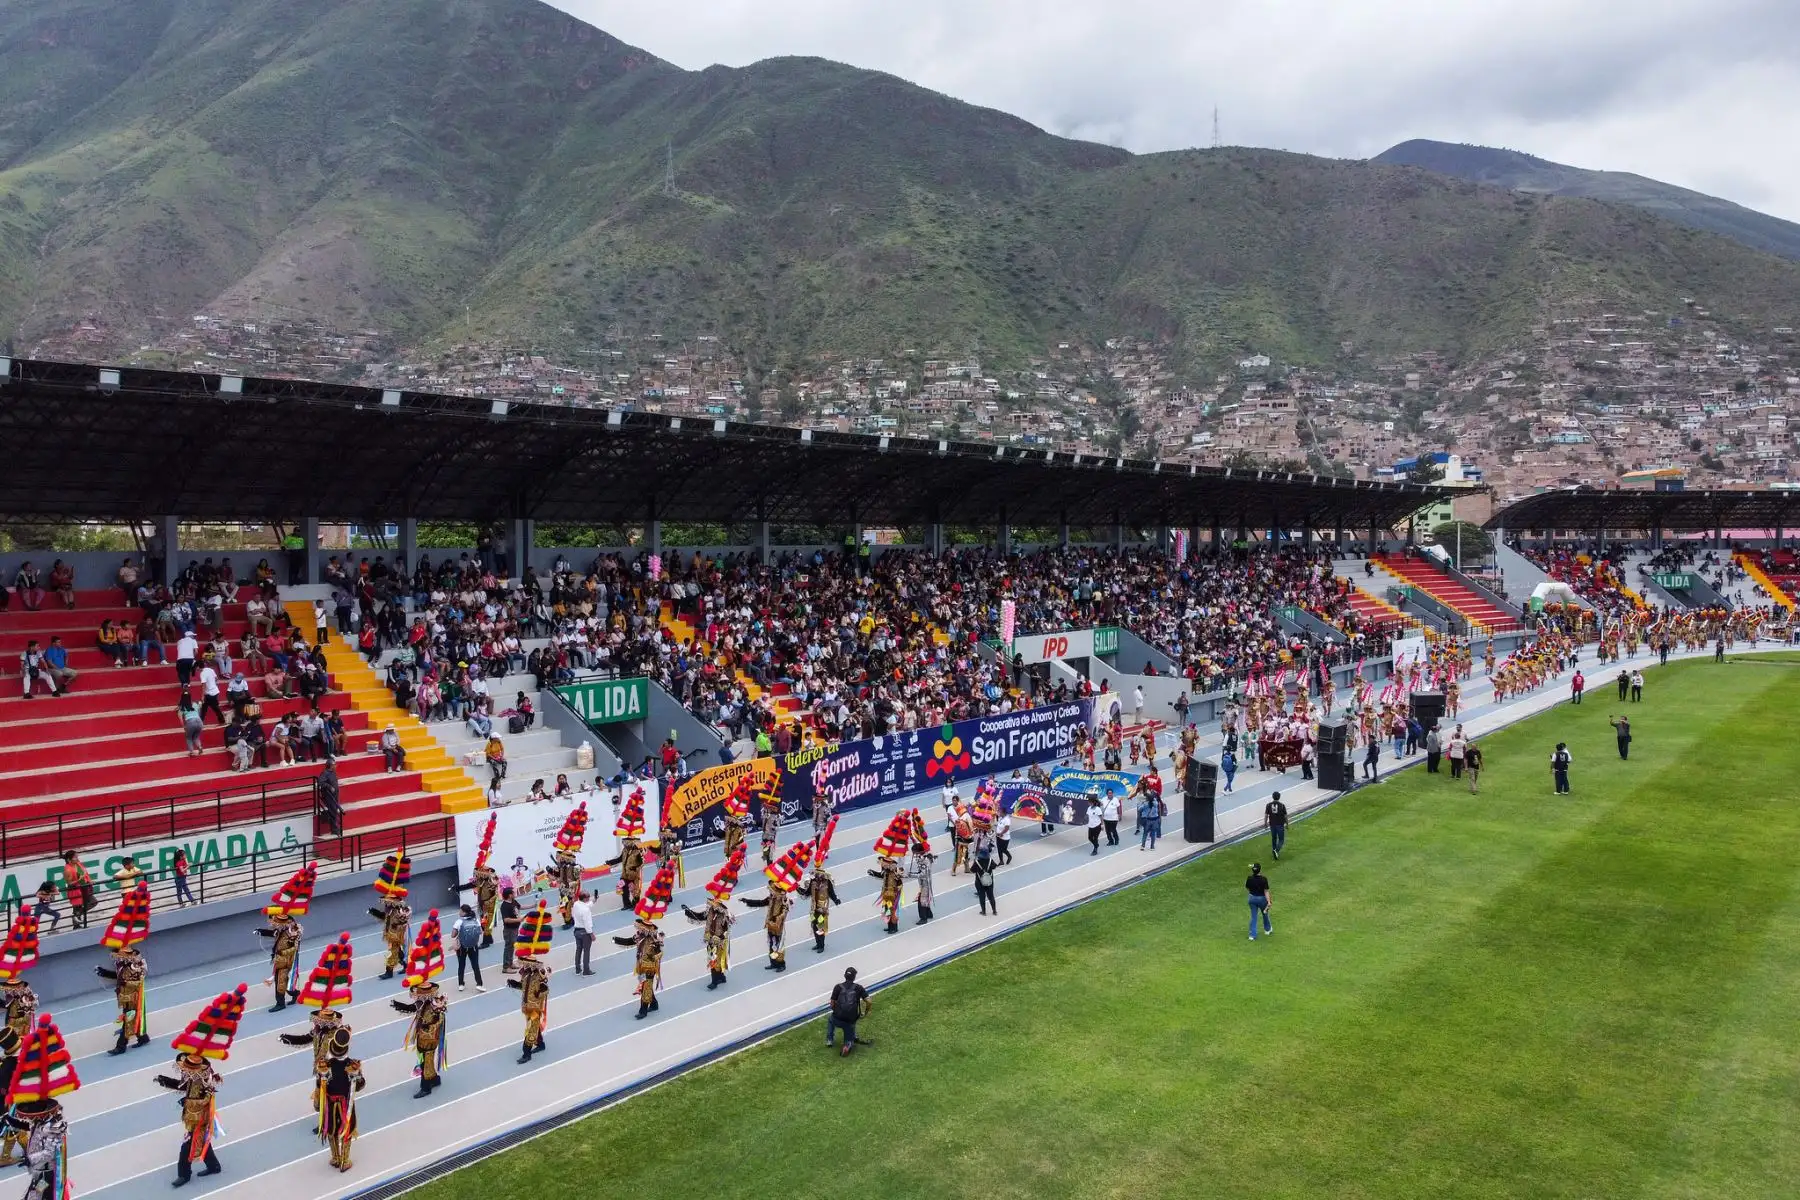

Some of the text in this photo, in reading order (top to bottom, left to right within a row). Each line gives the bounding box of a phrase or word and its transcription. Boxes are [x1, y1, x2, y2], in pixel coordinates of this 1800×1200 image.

[1652, 576, 1690, 588] ALIDA
[1043, 637, 1068, 659] IPD
[1095, 630, 1118, 652] SALIDA
[980, 717, 1020, 733] Cooperativa
[1021, 714, 1030, 725] de
[1031, 711, 1053, 724] Ahorro
[1053, 710, 1058, 720] y
[785, 743, 840, 774] Lideres en
[972, 737, 1006, 765] San
[683, 763, 753, 802] Tu Préstamo
[728, 782, 734, 794] y
[1022, 783, 1049, 795] TIERRA
[1050, 790, 1089, 801] COLONIAL
[544, 816, 556, 825] 200
